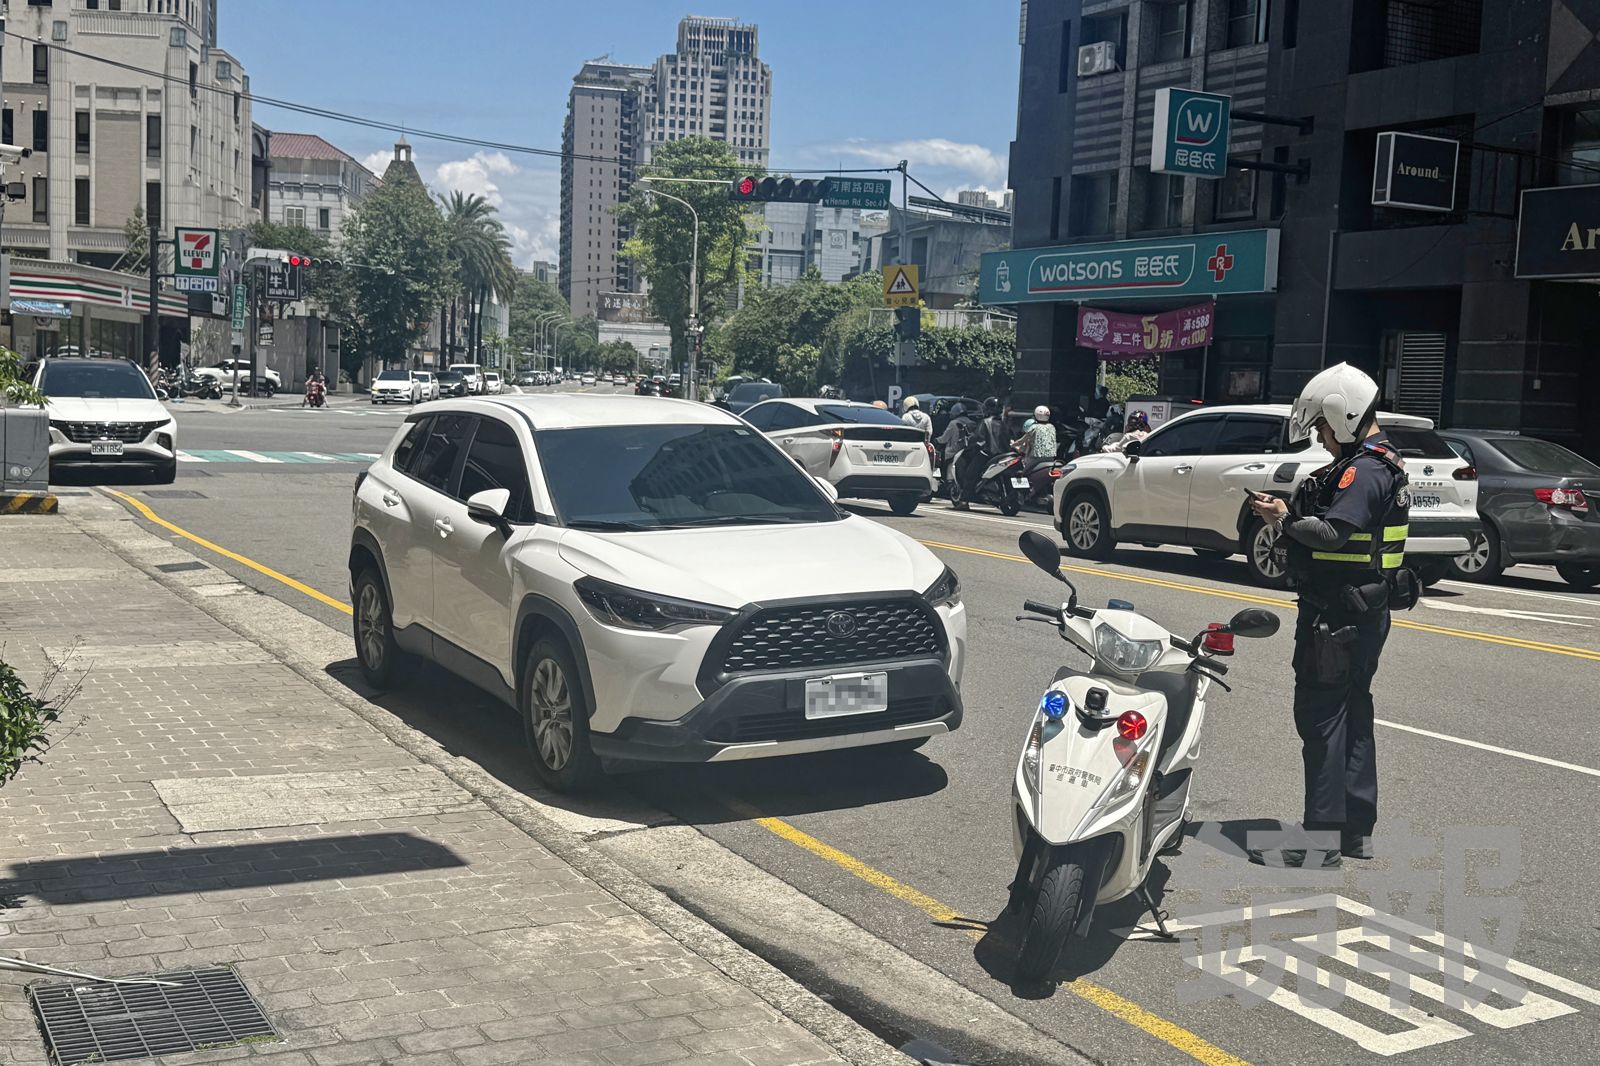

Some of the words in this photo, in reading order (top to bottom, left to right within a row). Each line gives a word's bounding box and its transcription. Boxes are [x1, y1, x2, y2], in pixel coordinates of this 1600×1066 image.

[1175, 149, 1216, 170] 屈臣氏
[1397, 162, 1439, 179] Around
[1134, 255, 1180, 278] 屈臣氏
[888, 385, 903, 409] P
